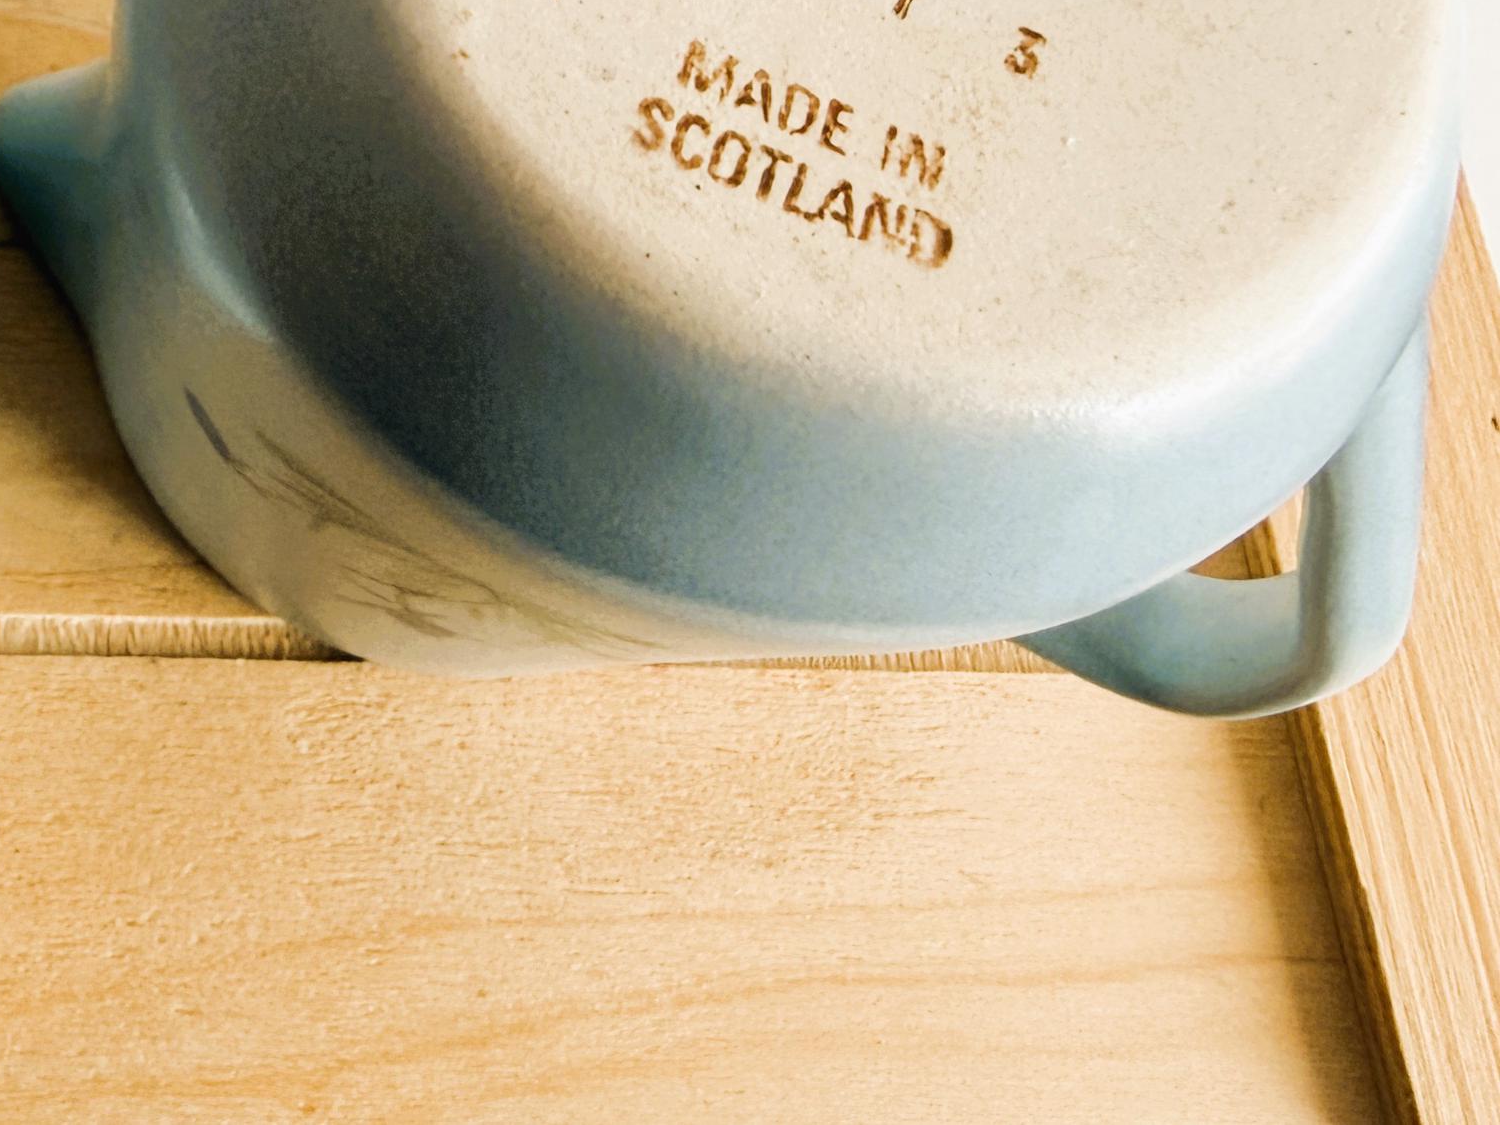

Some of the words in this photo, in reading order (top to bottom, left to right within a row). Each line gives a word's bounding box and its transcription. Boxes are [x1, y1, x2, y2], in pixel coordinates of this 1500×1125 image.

[677, 38, 855, 157] MADE
[880, 124, 948, 192] IN
[1003, 26, 1047, 78] 3
[630, 95, 955, 269] SCOTLAND
